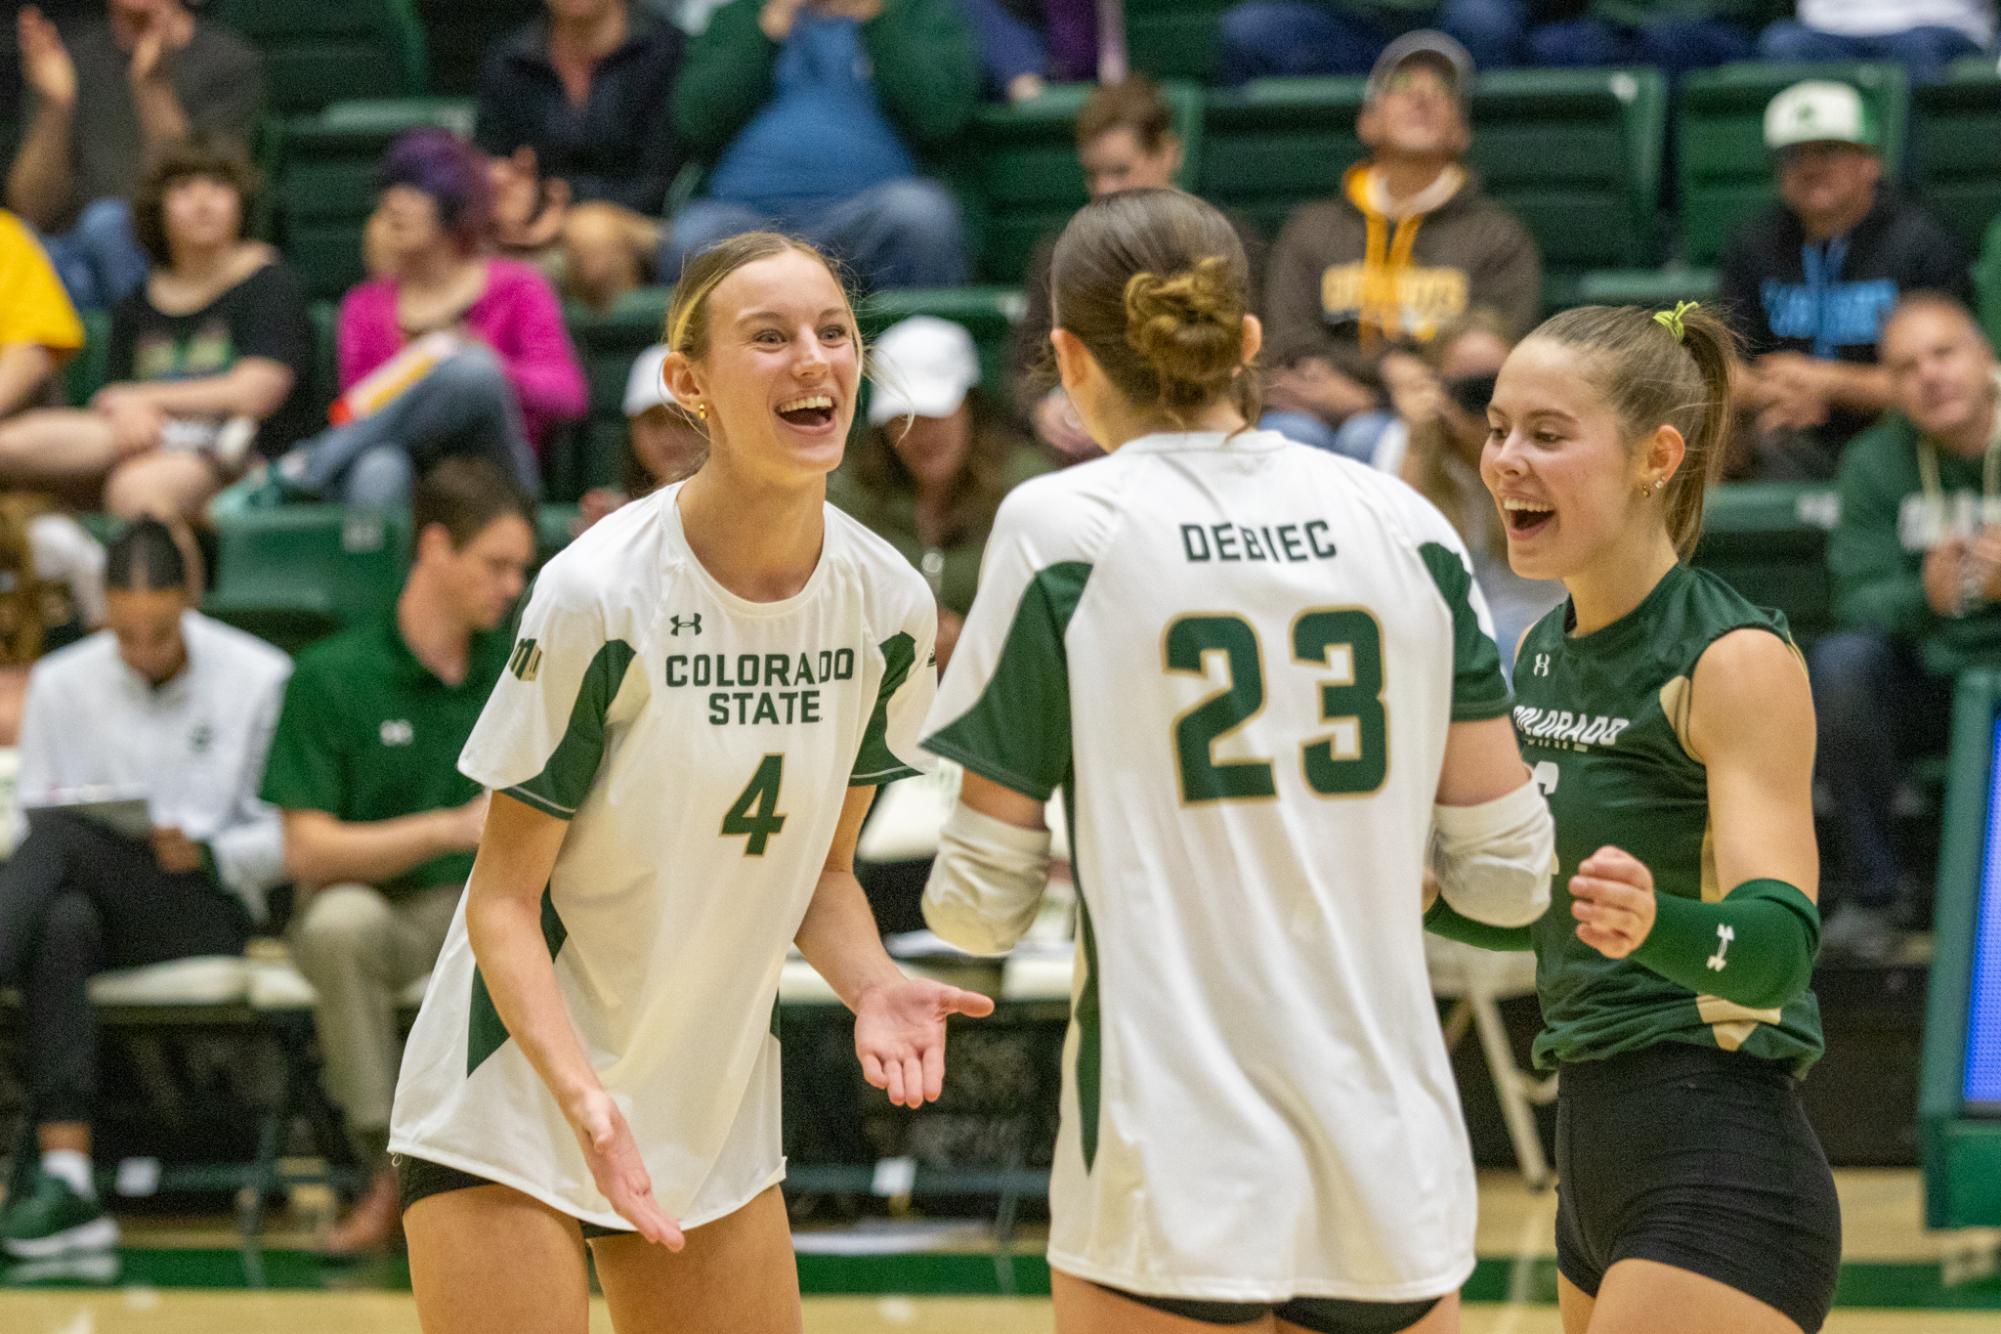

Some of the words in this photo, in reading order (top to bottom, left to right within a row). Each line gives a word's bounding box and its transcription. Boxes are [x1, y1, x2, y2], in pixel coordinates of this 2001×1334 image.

[1180, 520, 1337, 562] DEBIEC
[666, 647, 855, 688] COLORADO
[708, 690, 821, 726] STATE
[1159, 604, 1391, 809] 23
[719, 752, 788, 858] 4
